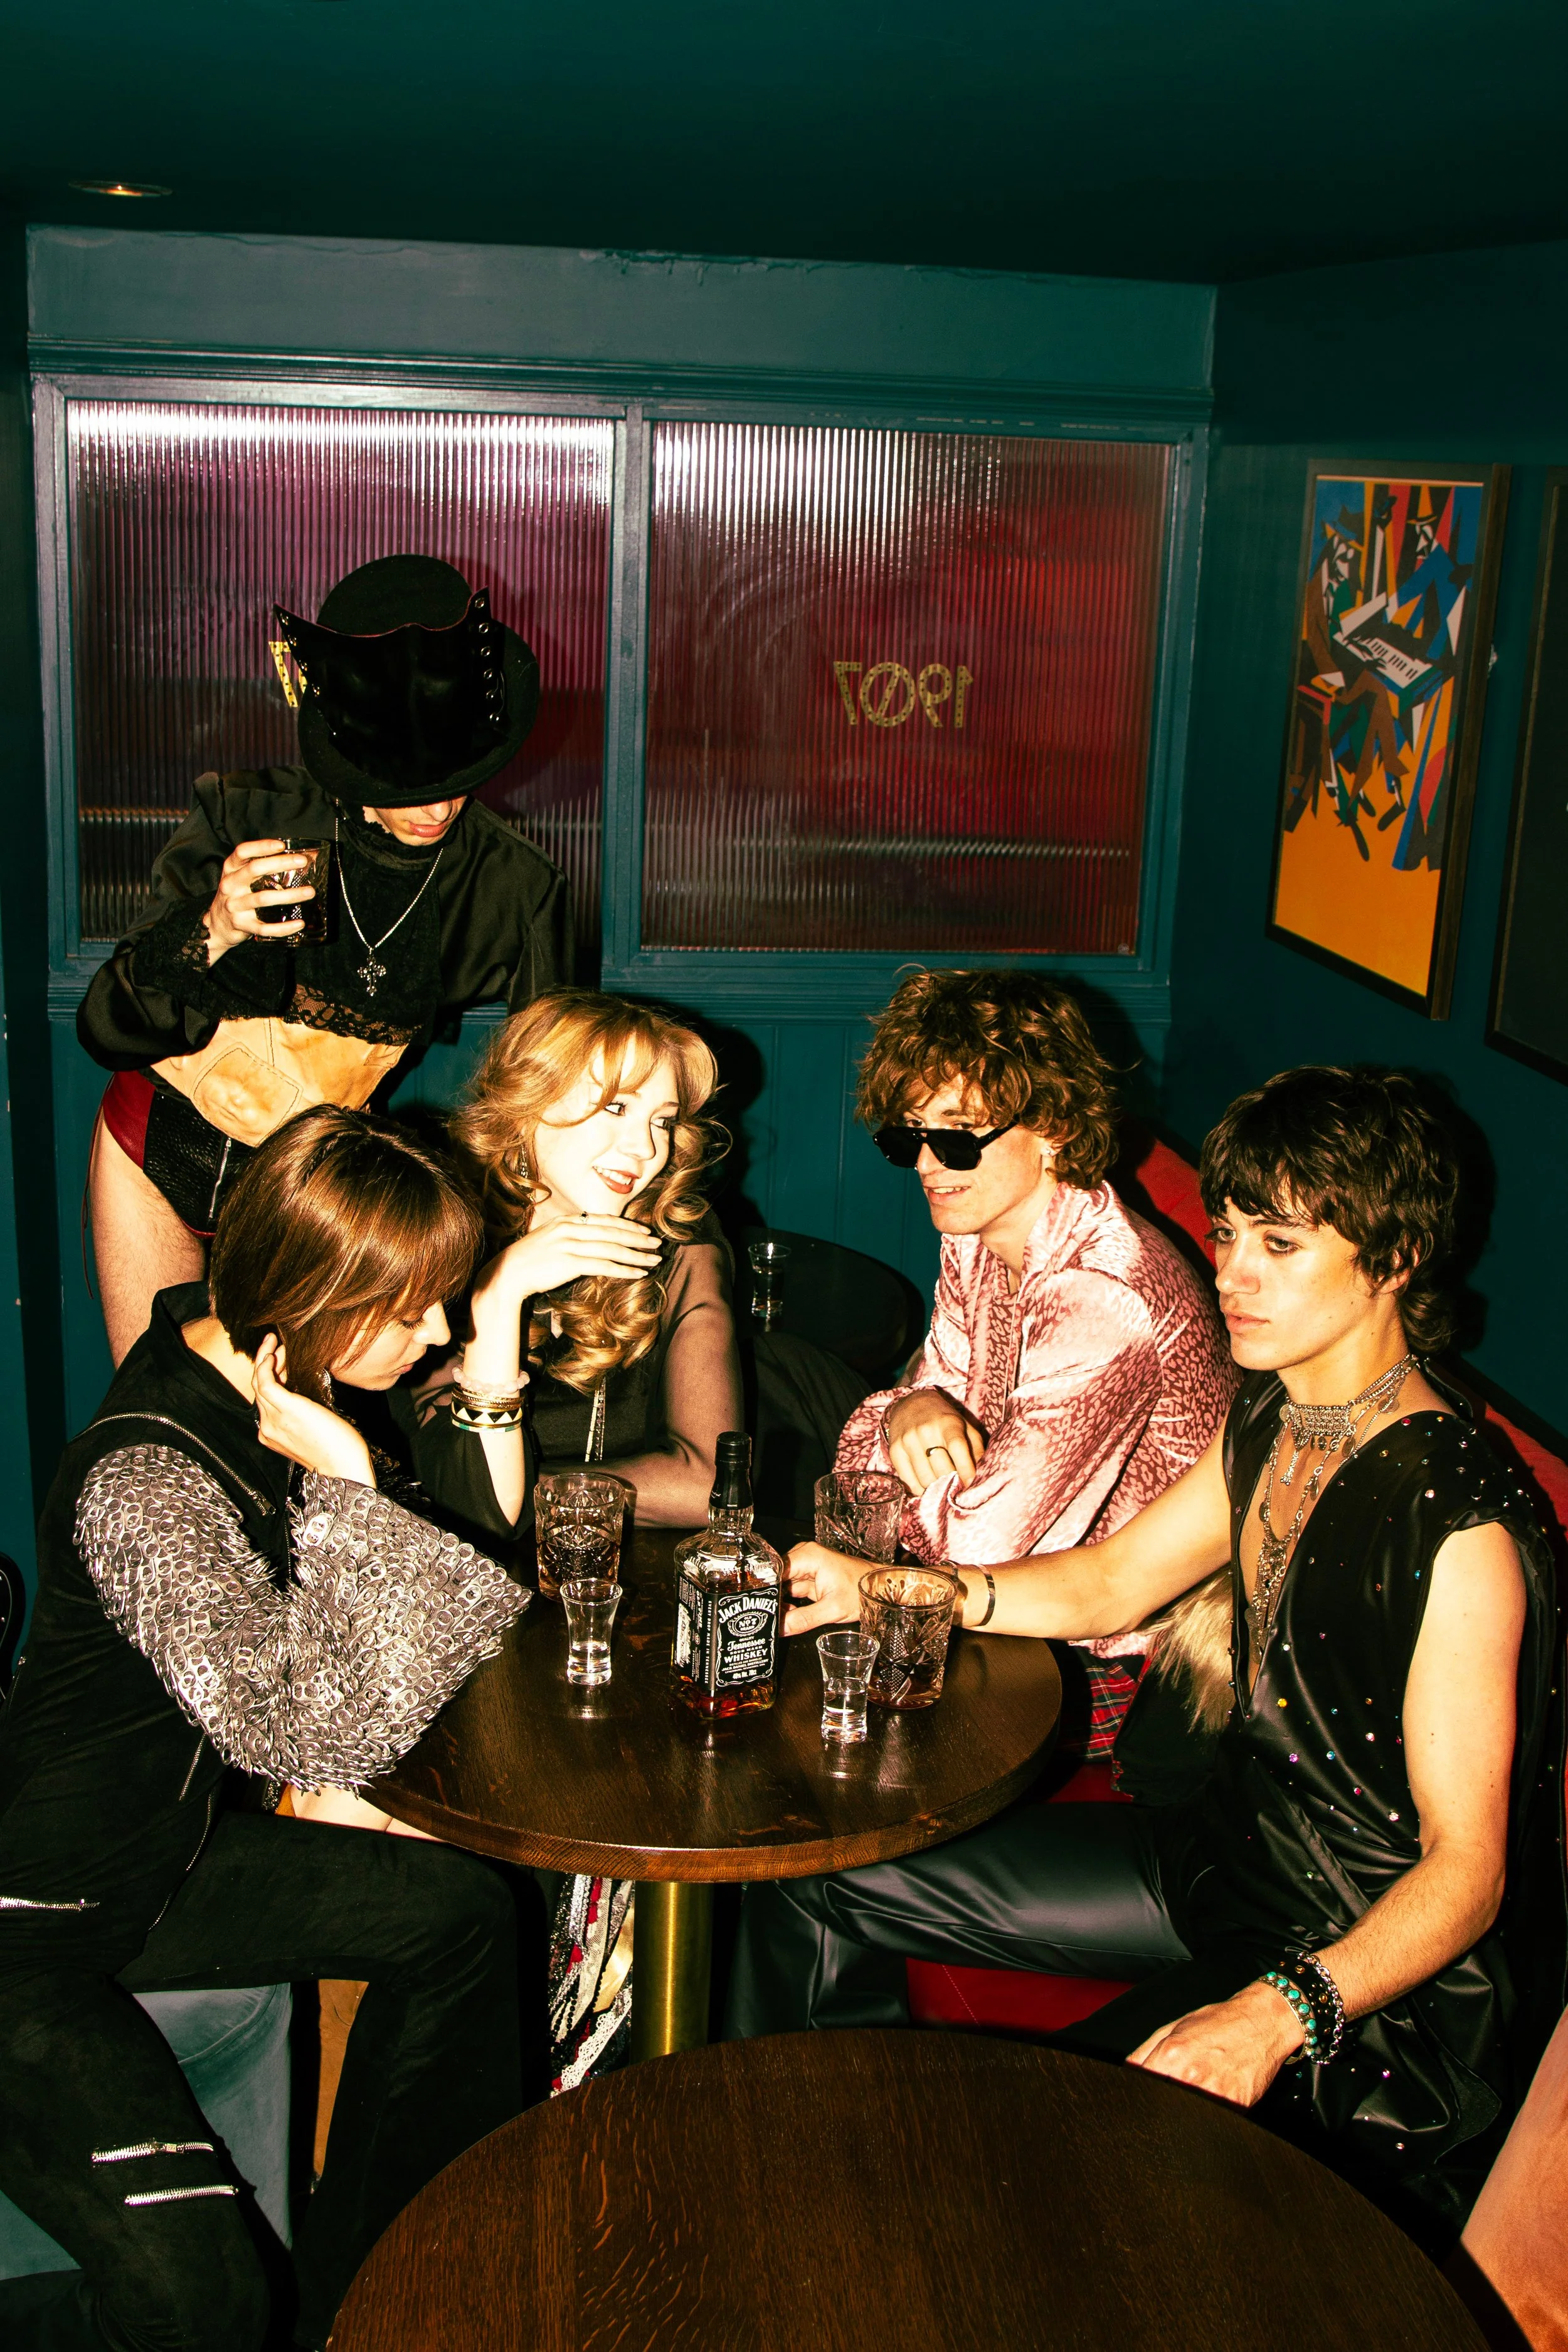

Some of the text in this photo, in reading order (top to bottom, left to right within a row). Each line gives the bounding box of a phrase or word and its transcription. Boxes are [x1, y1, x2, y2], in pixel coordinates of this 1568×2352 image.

[718, 1601, 743, 1623] JACK
[743, 1597, 778, 1614] DANIEL'S
[727, 1638, 766, 1651] Tennessee
[724, 1648, 768, 1663] WHISKEY
